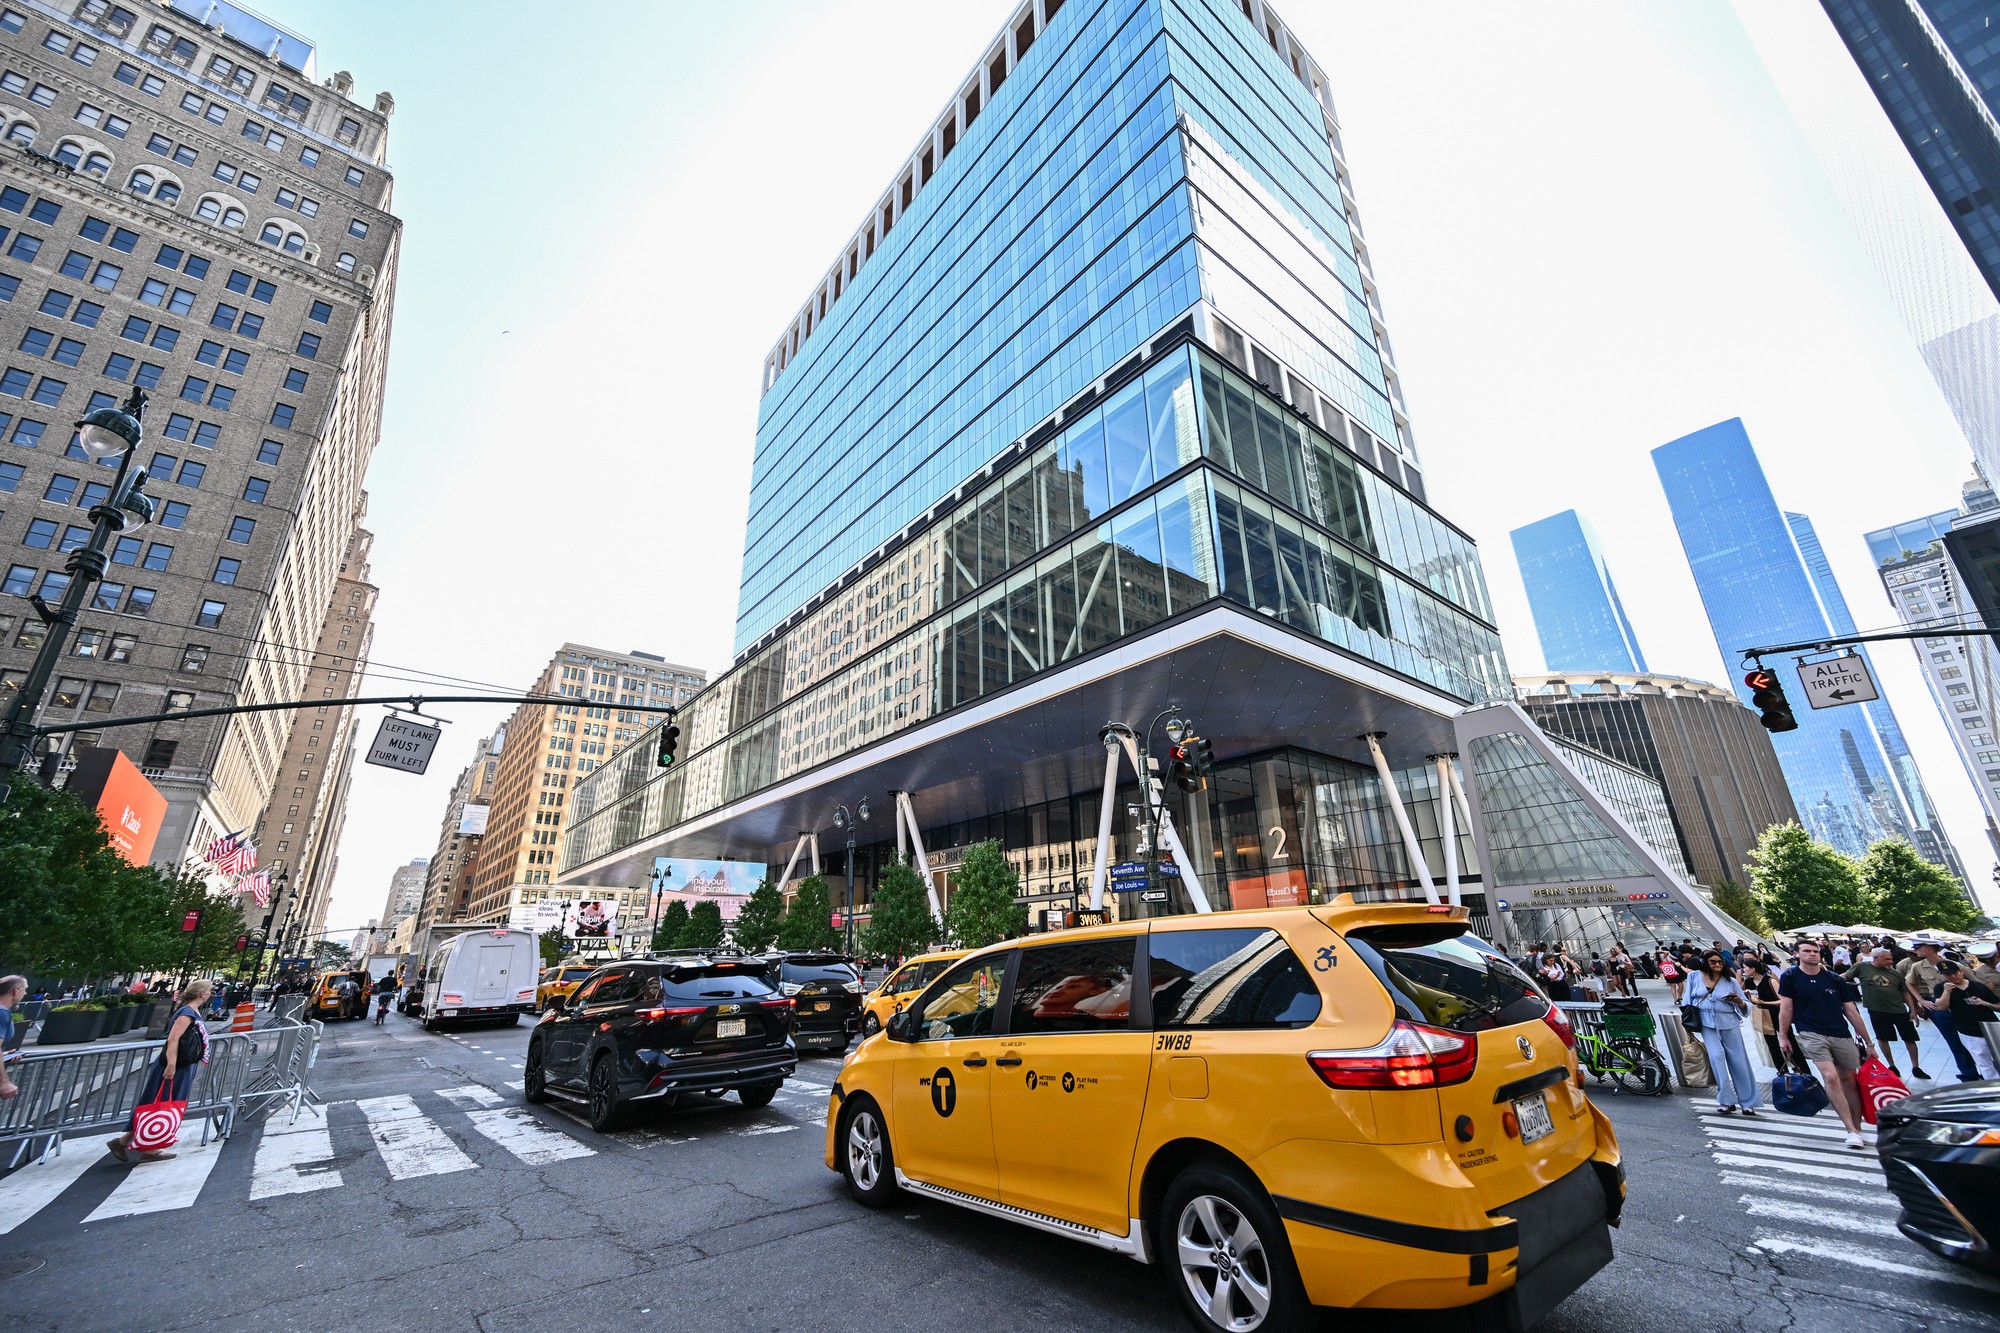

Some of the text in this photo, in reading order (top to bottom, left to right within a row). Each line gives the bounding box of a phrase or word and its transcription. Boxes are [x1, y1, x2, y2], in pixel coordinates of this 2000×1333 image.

[1816, 663, 1849, 677] ALL
[1811, 673, 1862, 690] TRAFFIC
[385, 723, 434, 741] LEFT LANE
[388, 738, 420, 752] MUST
[374, 750, 424, 768] TURN LEFT
[1268, 826, 1290, 860] 2
[1111, 867, 1133, 875] Seventh
[686, 875, 726, 887] Find your
[1124, 881, 1137, 889] Louis
[1531, 884, 1616, 897] PENN STATION
[1079, 914, 1103, 926] 3W88
[1156, 1034, 1192, 1051] 3W88
[920, 1078, 930, 1086] NYC
[936, 1077, 950, 1111] T
[1467, 1148, 1485, 1158] CAUTION
[1460, 1154, 1498, 1170] PASSENGER EXITING
